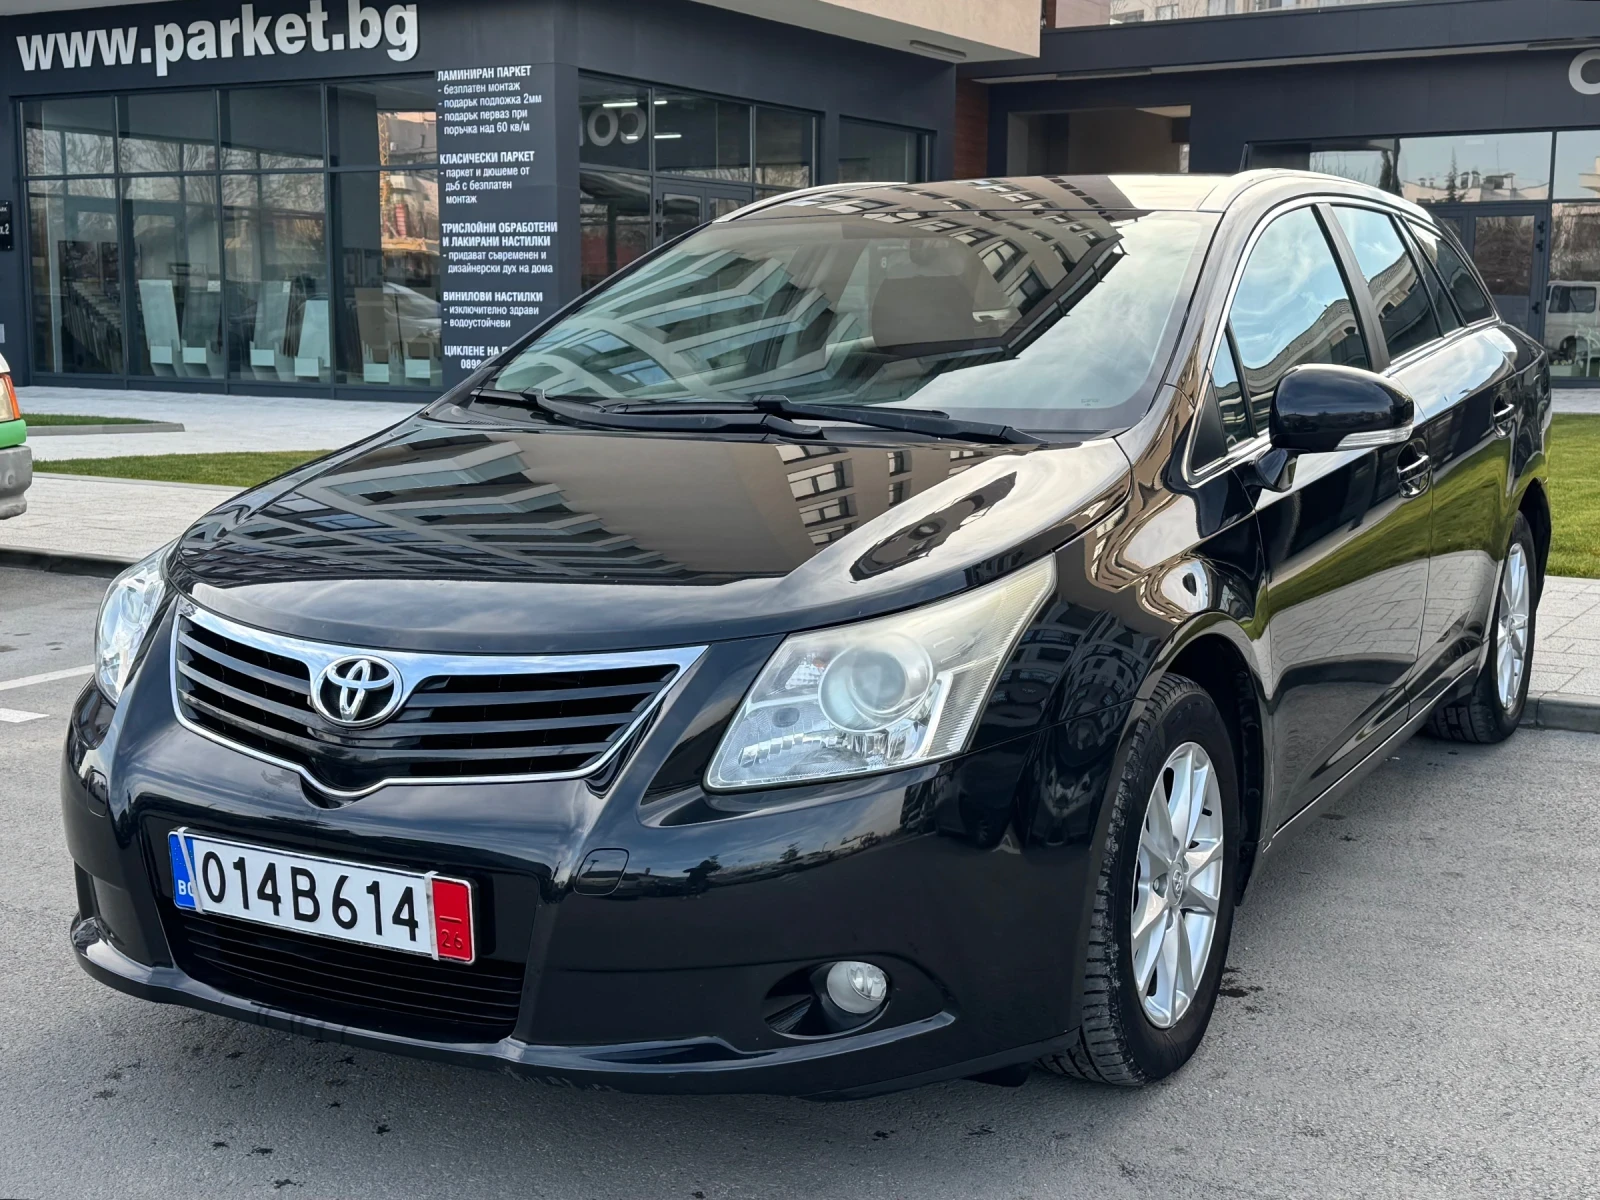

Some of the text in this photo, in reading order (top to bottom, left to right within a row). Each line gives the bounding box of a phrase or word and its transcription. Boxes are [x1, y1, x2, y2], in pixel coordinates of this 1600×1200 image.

[16, 0, 418, 76] www.parket.bg
[437, 65, 531, 81] ЛАМИНИРАН ПАРКЕТ
[444, 84, 485, 94] безплатен
[488, 82, 520, 92] монтаж
[480, 95, 521, 106] подложка
[524, 93, 542, 104] 2мм
[480, 110, 509, 120] перваз
[512, 109, 528, 118] при
[480, 123, 494, 133] над
[497, 122, 507, 132] 60
[510, 121, 530, 133] кв/м
[440, 151, 535, 165] КЛАСИЧЕСКИ ПАРКЕТ
[446, 168, 473, 179] паркет
[483, 167, 518, 178] дюшеме
[521, 167, 530, 175] от
[462, 182, 467, 190] с
[470, 180, 512, 190] безплатен
[446, 195, 477, 204] монтаж
[442, 221, 557, 234] ТРИСЛОЙНИ ОБРАБОТЕНИ
[443, 236, 550, 247] И ЛАКИРАНИ НАСТИЛКИ
[449, 251, 485, 262] придават
[488, 251, 538, 261] съвременен
[448, 263, 500, 275] дизайнерски
[503, 264, 517, 275] дух
[531, 265, 553, 273] дома
[443, 292, 543, 301] ВИНИЛОВИ НАСТИЛКИ
[450, 306, 507, 315] изключително
[510, 306, 539, 316] здрави
[450, 317, 511, 329] водоустойчеви
[444, 345, 484, 357] ЦИКЛЕНЕ
[487, 346, 499, 356] НА
[202, 851, 418, 941] 014B614
